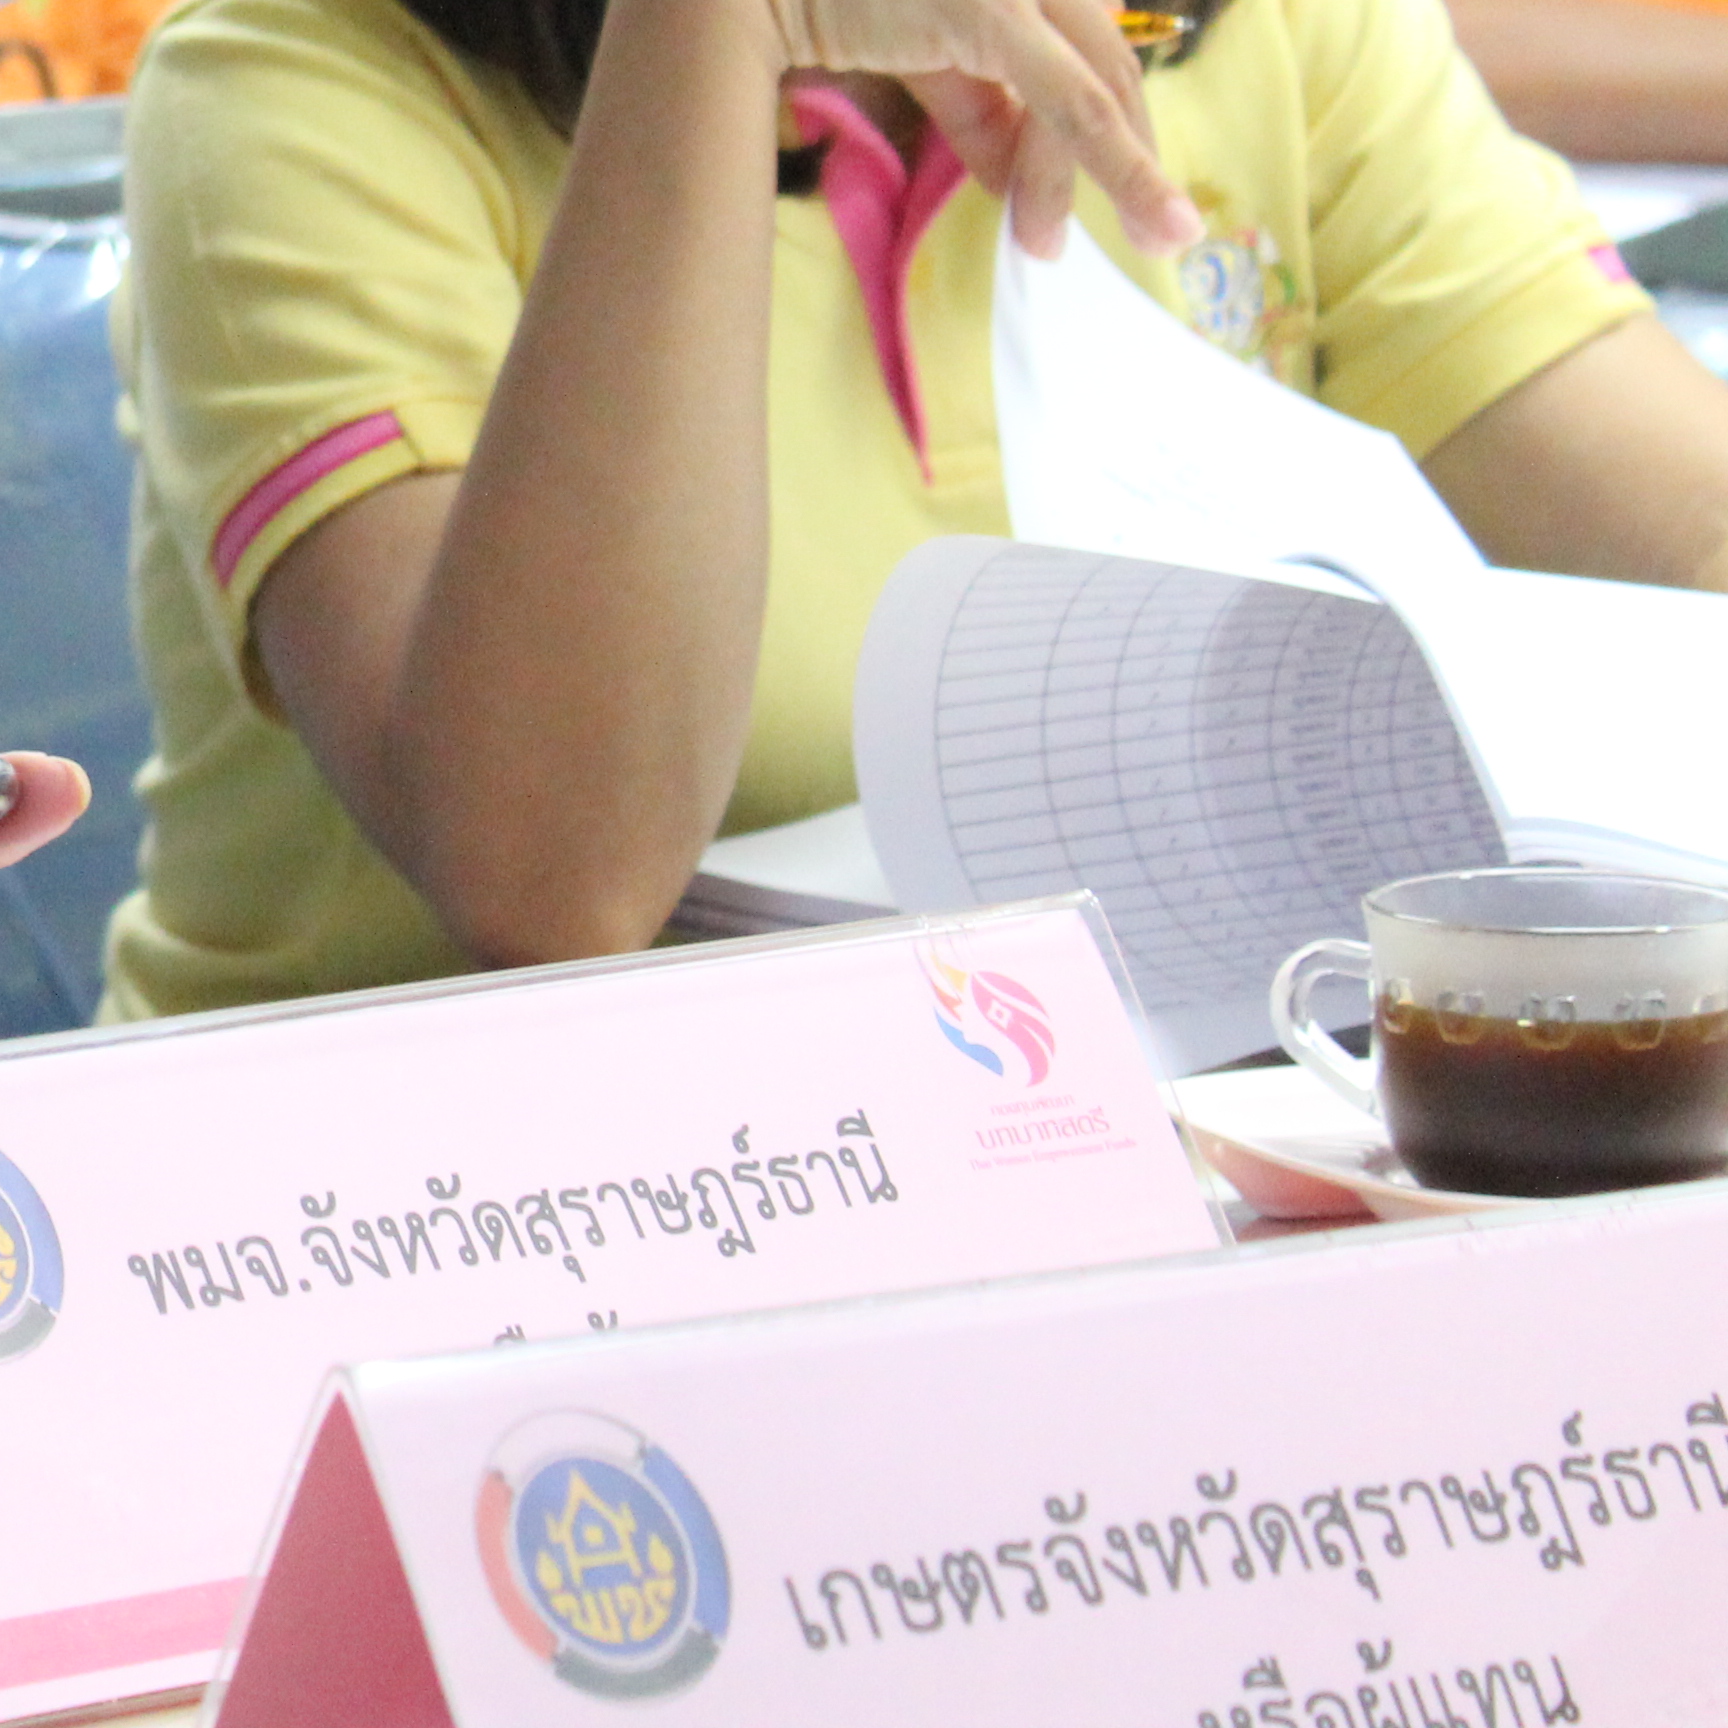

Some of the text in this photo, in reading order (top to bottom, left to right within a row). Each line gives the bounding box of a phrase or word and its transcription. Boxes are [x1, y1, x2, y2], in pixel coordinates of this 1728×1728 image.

[974, 1105, 1112, 1151] บทบาทสตรี
[127, 1109, 899, 1316] พมจ.จังหวัดสุราษฎร์ธานี
